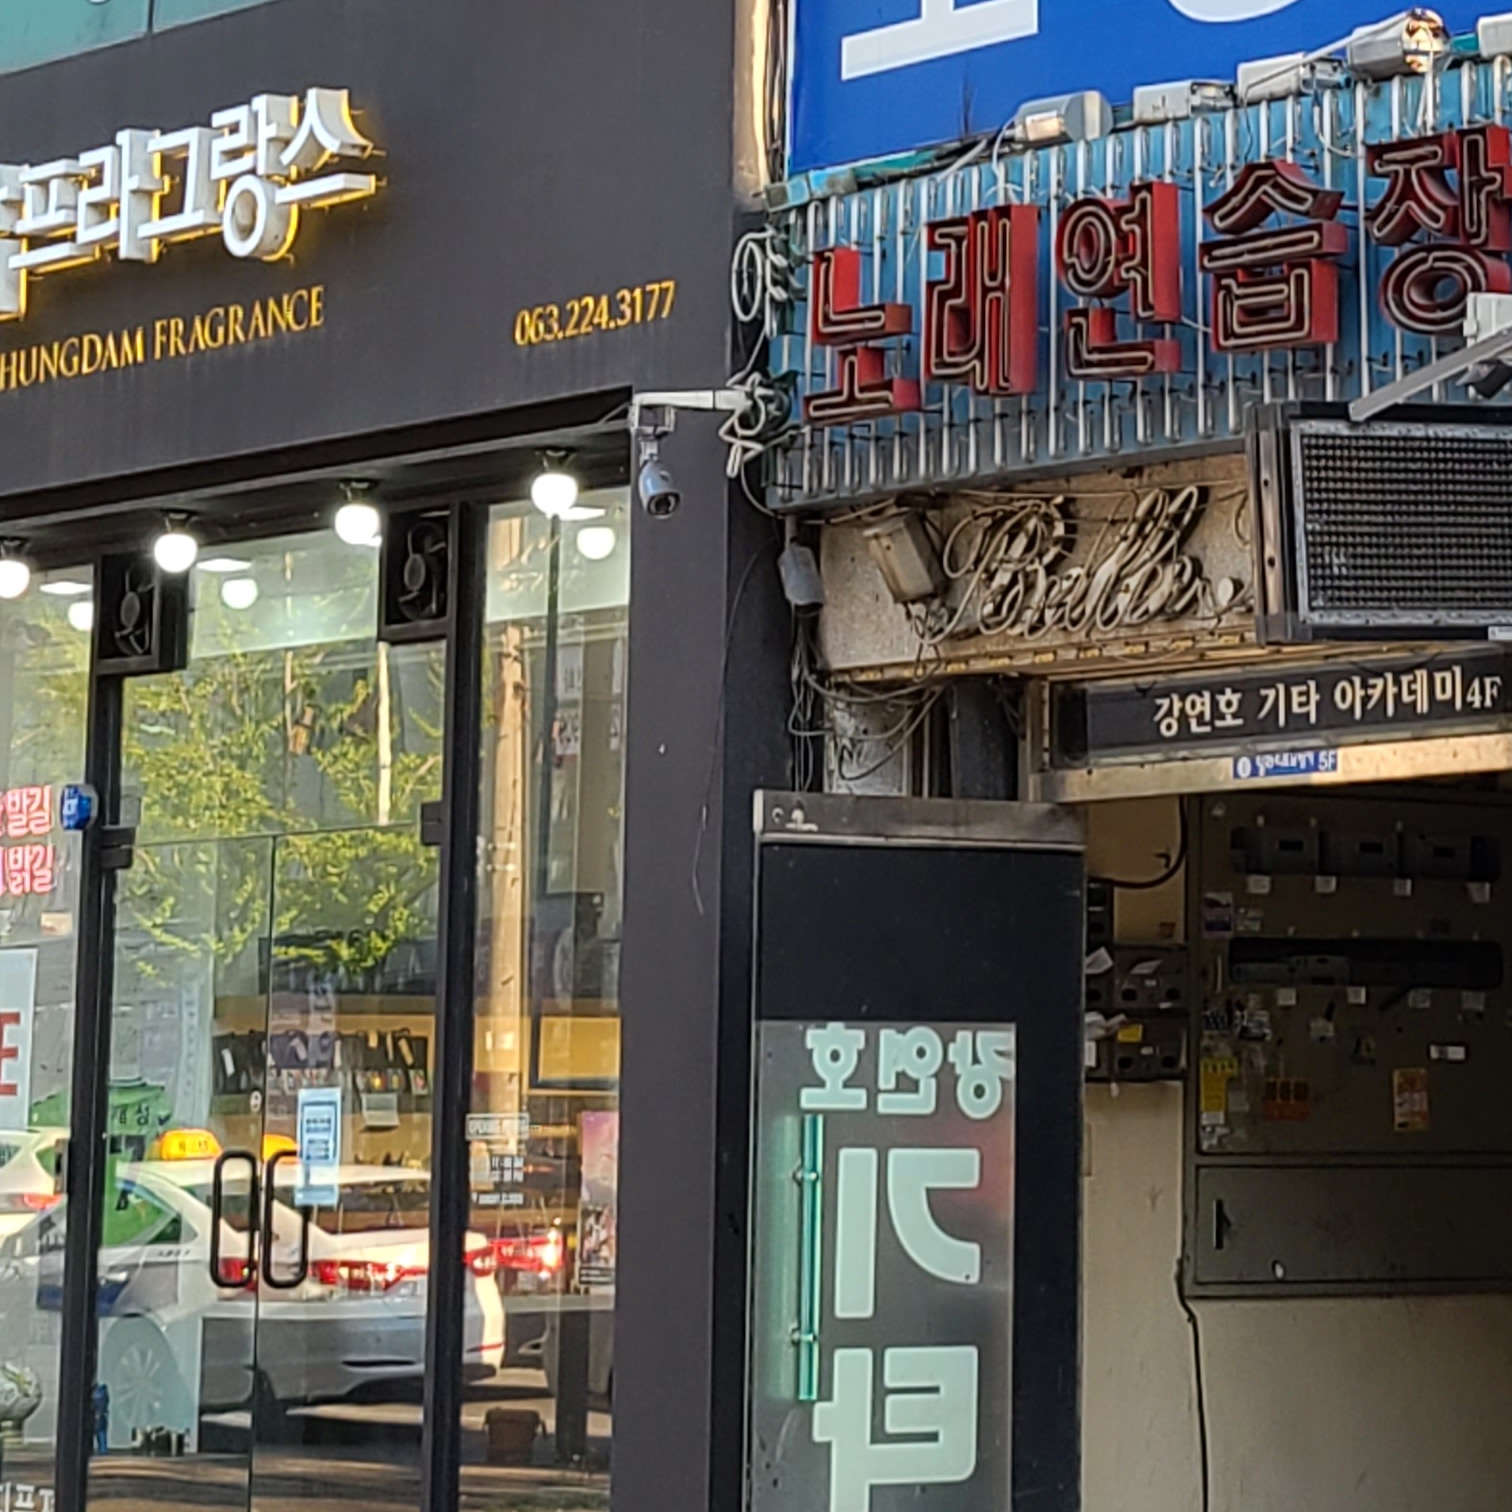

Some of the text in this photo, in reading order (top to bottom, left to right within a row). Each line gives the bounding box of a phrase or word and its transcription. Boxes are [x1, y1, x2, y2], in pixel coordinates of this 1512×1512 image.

[153, 285, 325, 360] FRAGRANCE
[514, 280, 676, 345] 063.224.3177
[1153, 687, 1244, 738] 강연호
[1257, 679, 1321, 729] 기타
